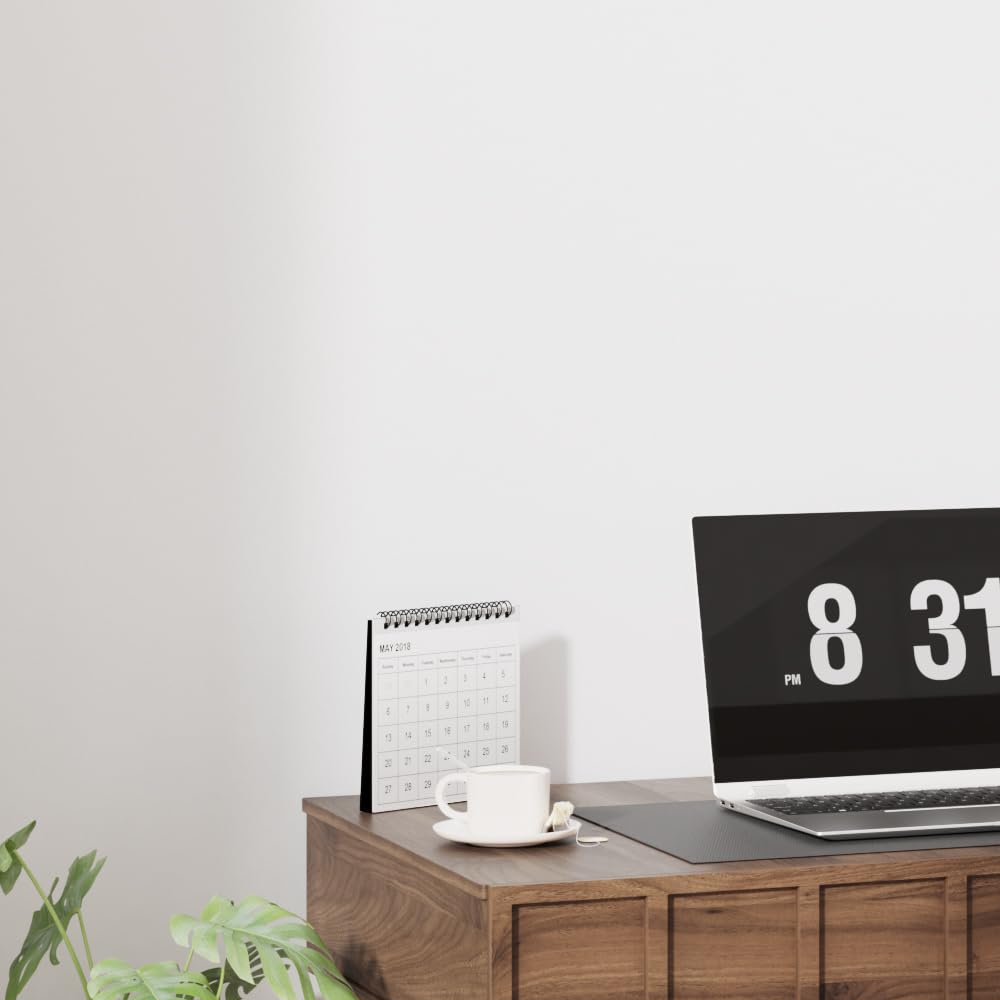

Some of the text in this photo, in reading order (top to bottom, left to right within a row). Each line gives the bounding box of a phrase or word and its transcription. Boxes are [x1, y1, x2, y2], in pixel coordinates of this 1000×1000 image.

[784, 673, 801, 686] PM
[807, 582, 863, 686] 8
[379, 642, 411, 653] MAY 2018
[424, 754, 432, 763] 22
